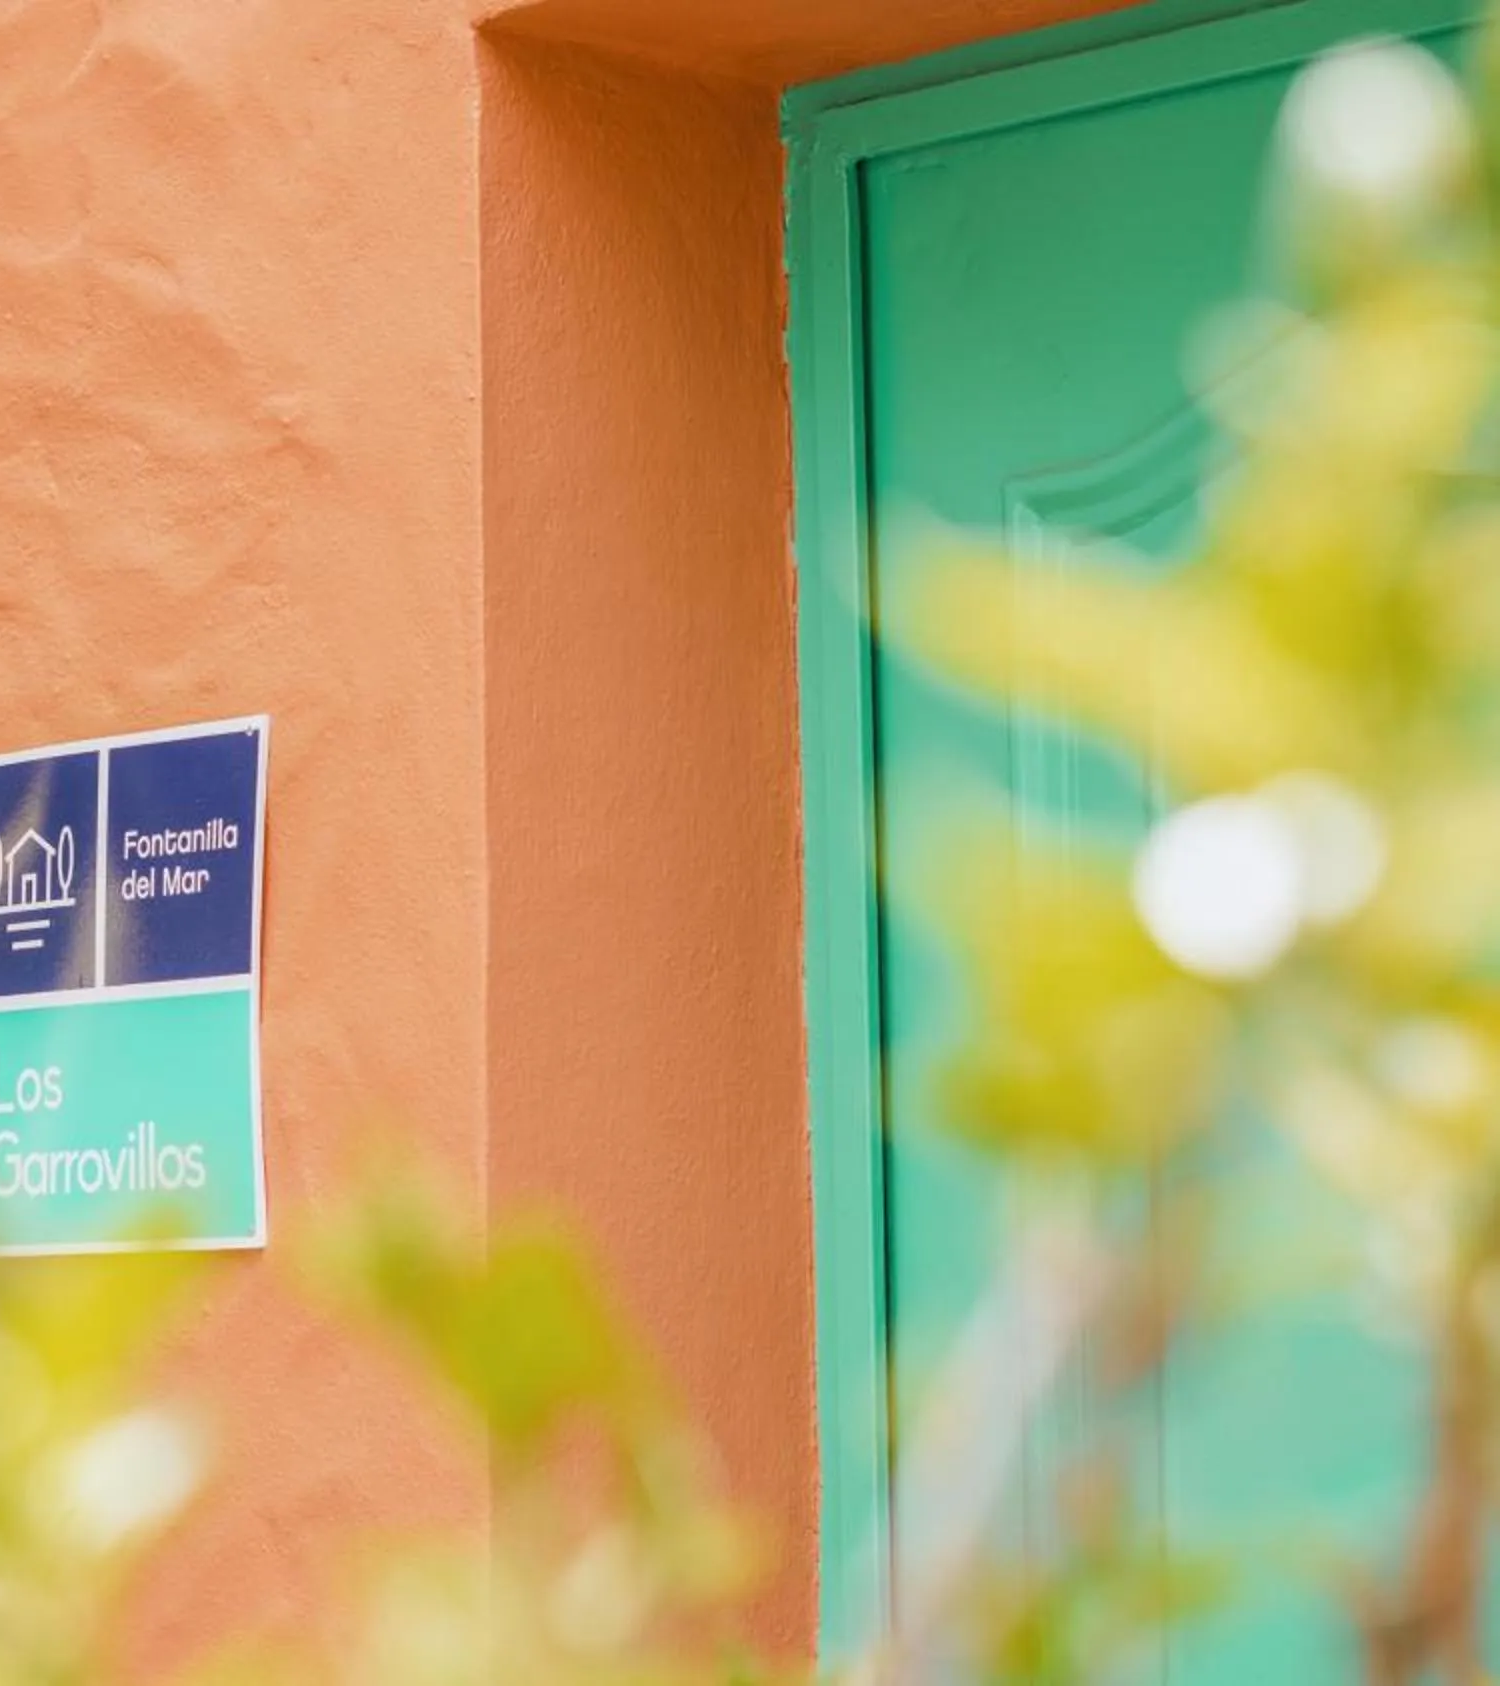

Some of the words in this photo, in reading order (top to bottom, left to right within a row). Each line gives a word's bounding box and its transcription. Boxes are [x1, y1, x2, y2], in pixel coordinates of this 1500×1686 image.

[122, 818, 238, 860] Fontanilla
[120, 867, 155, 901] del
[162, 865, 210, 898] Mar
